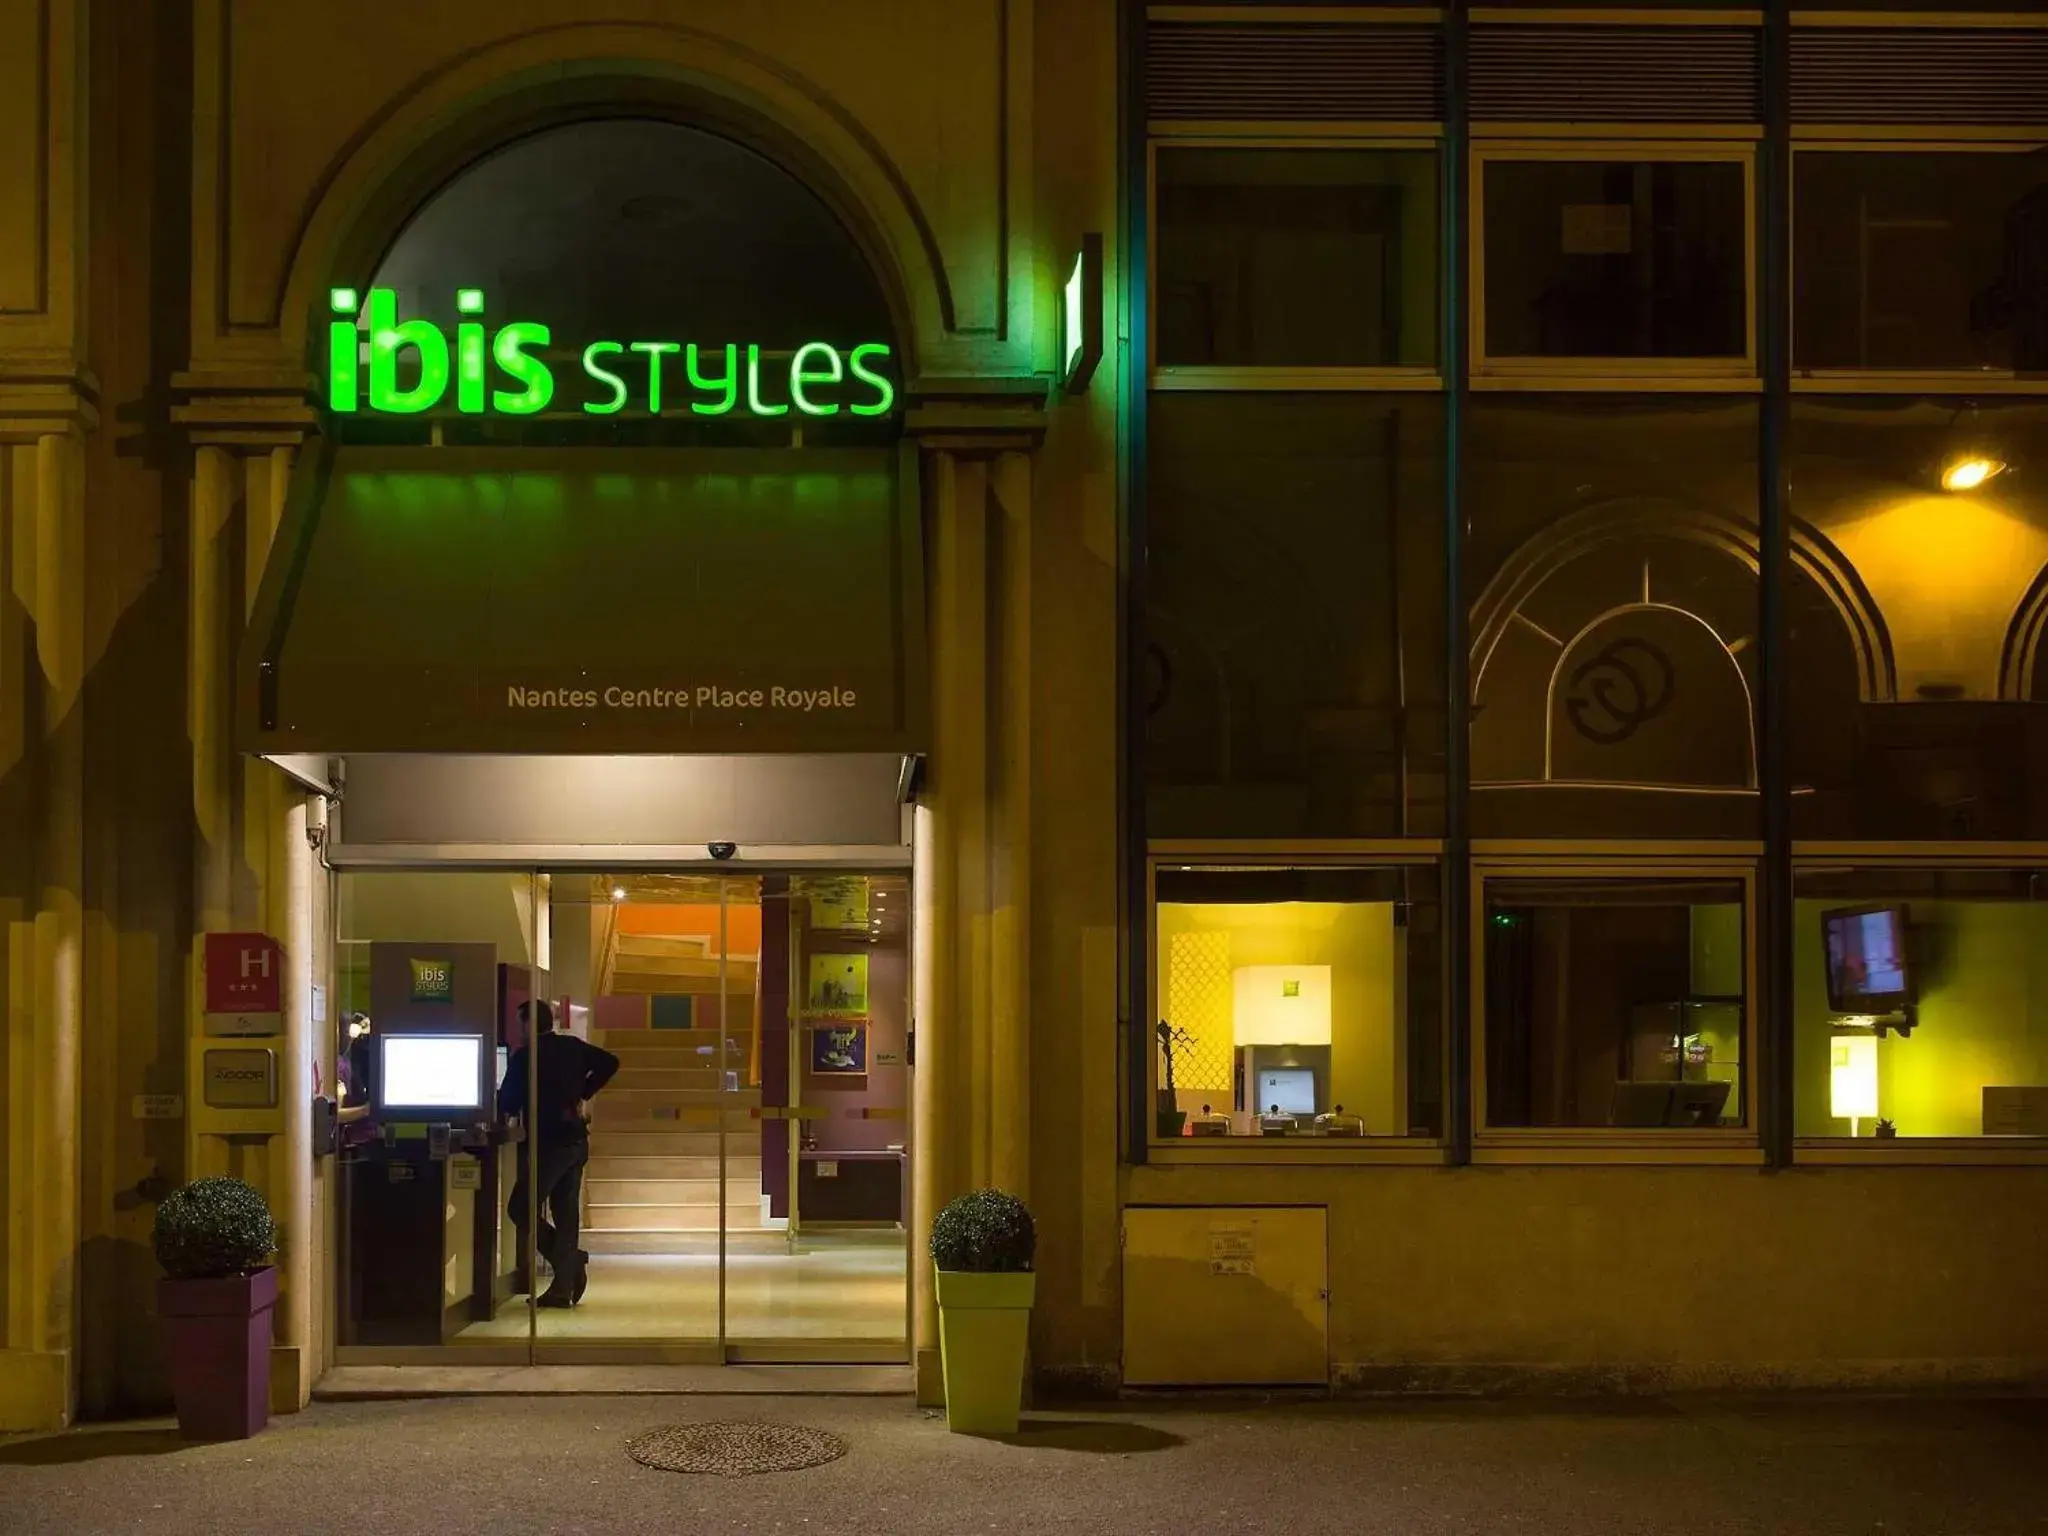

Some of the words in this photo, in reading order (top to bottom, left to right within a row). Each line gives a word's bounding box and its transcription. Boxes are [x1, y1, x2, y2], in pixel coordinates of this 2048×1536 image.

[330, 288, 554, 413] ibis
[508, 686, 598, 708] Nantes
[604, 686, 689, 708] Centre
[696, 686, 763, 708] Place
[771, 686, 856, 711] Royale
[241, 949, 270, 978] H
[420, 966, 445, 981] ibis
